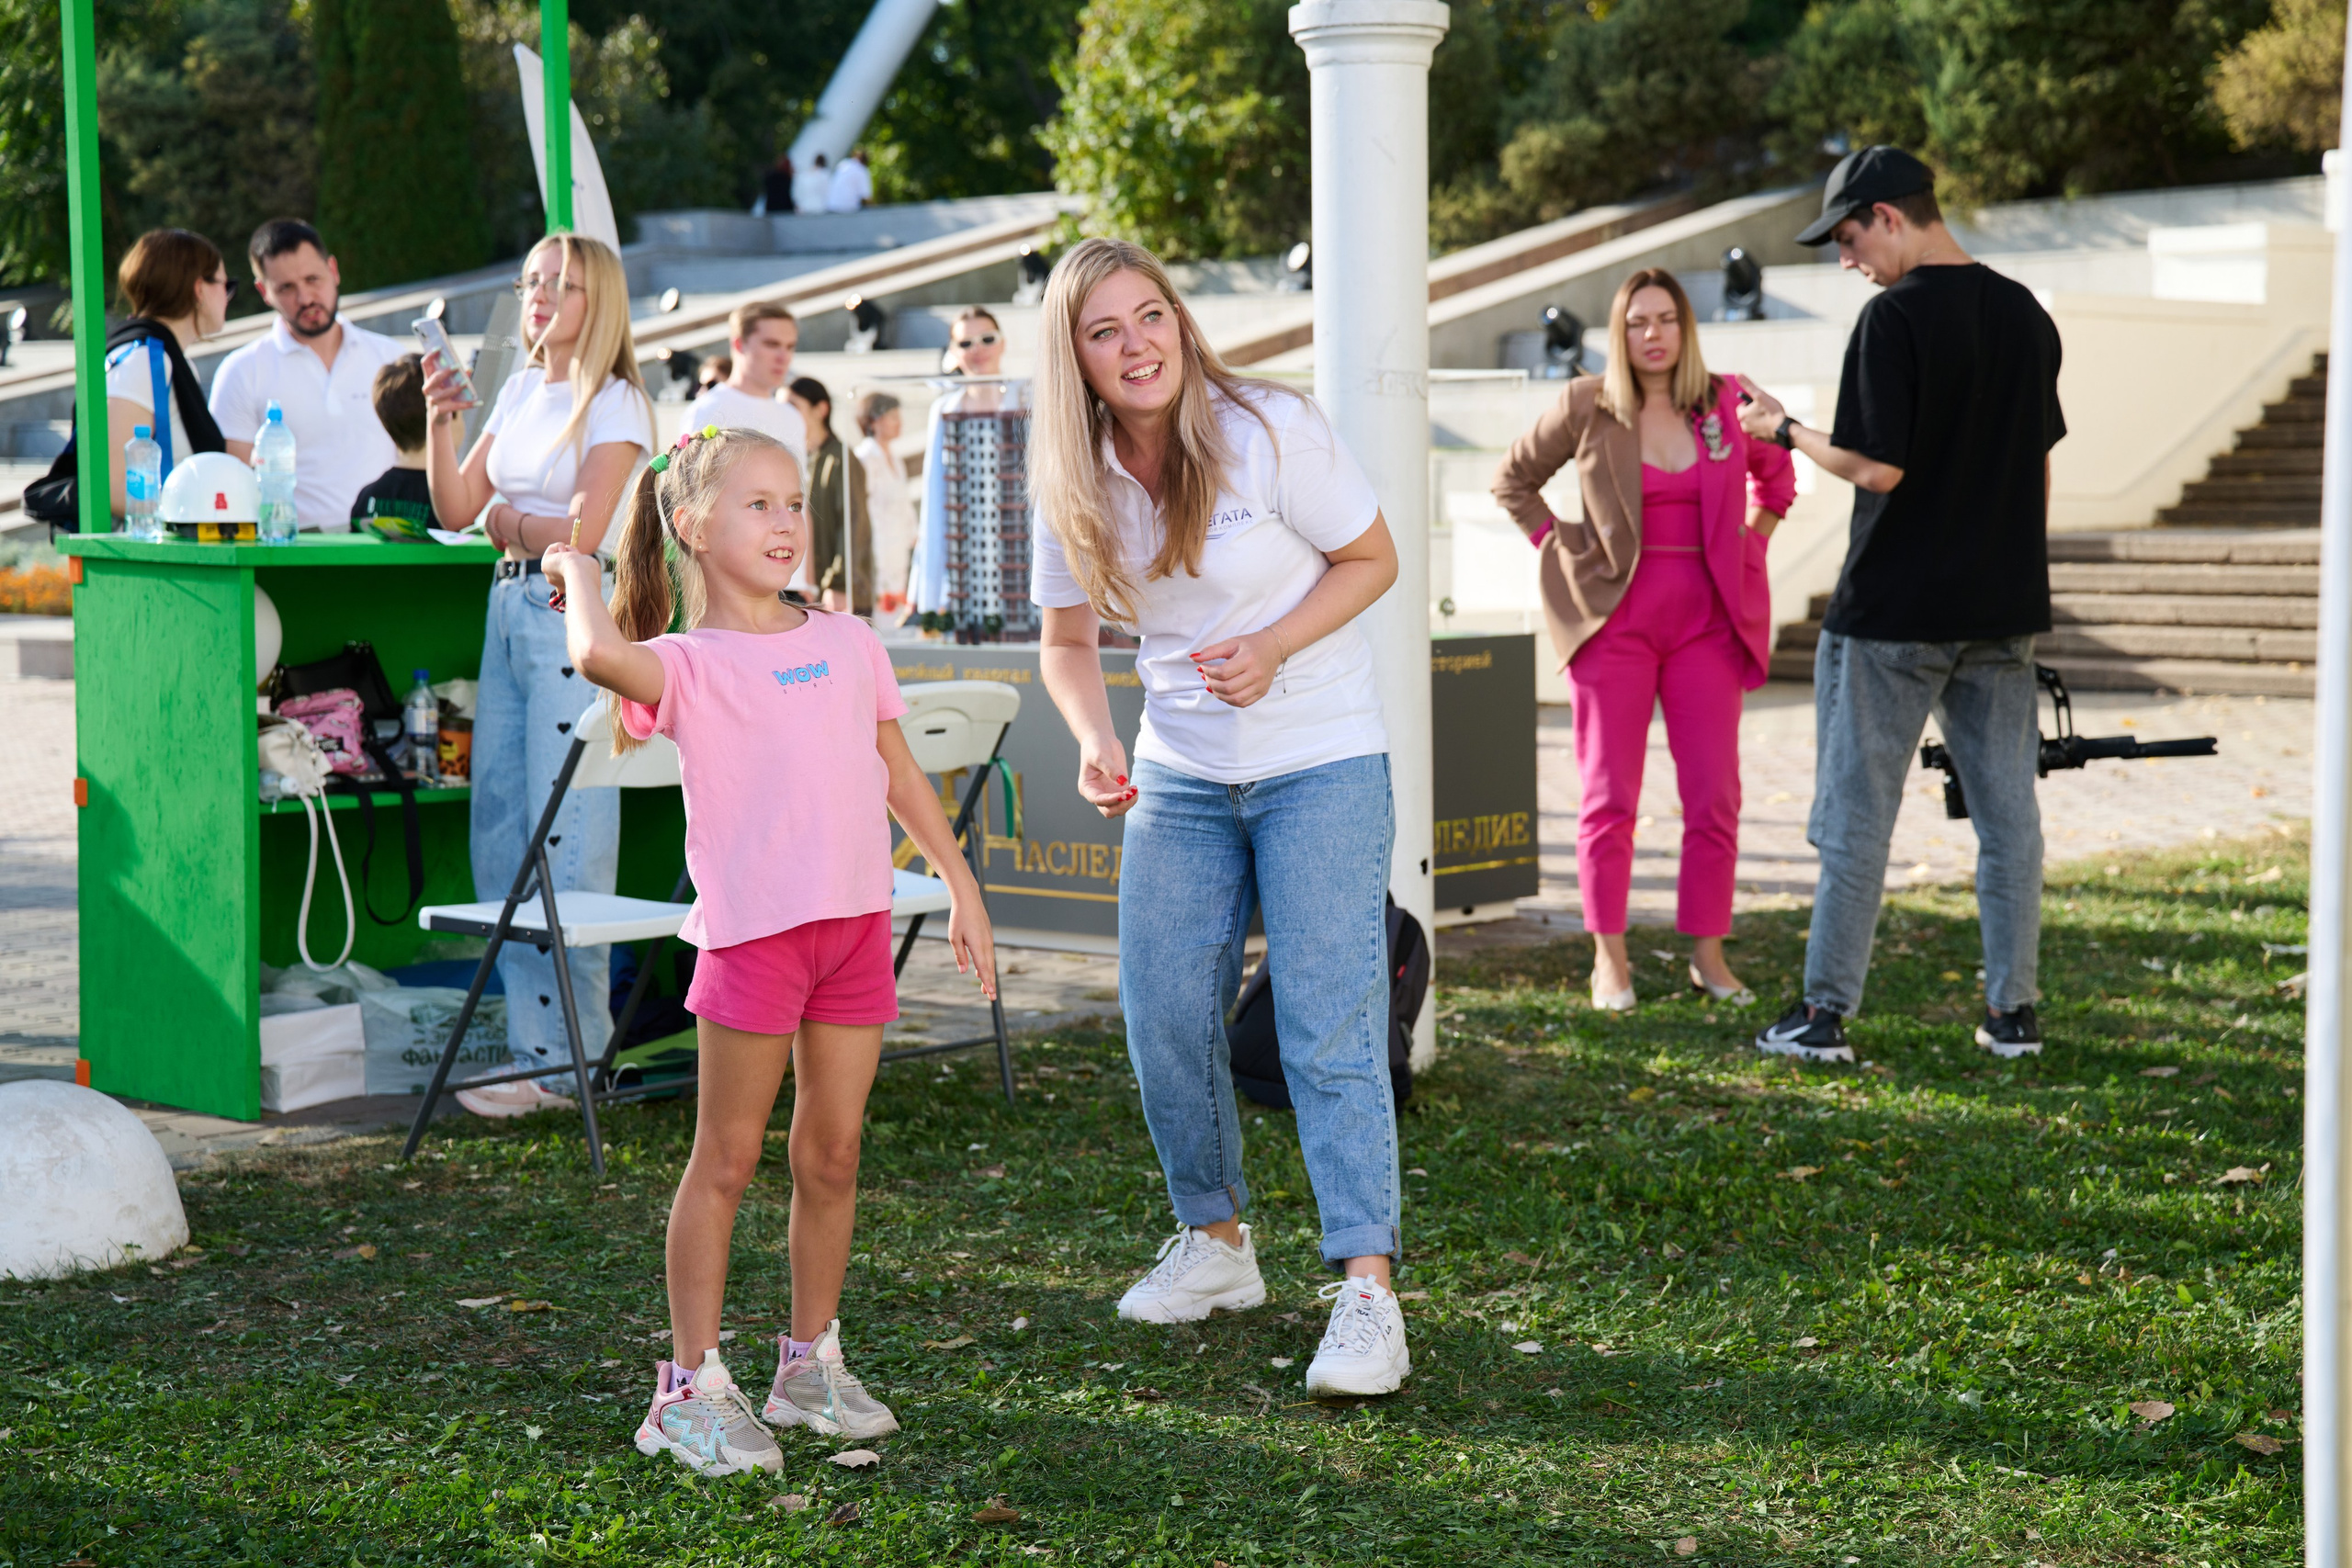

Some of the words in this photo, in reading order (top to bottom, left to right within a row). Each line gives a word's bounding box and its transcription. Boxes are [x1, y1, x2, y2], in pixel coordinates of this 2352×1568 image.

[772, 660, 829, 686] WOW
[983, 770, 1124, 886] НАСЛЕД
[1433, 811, 1530, 856] ЛЕДИЕ
